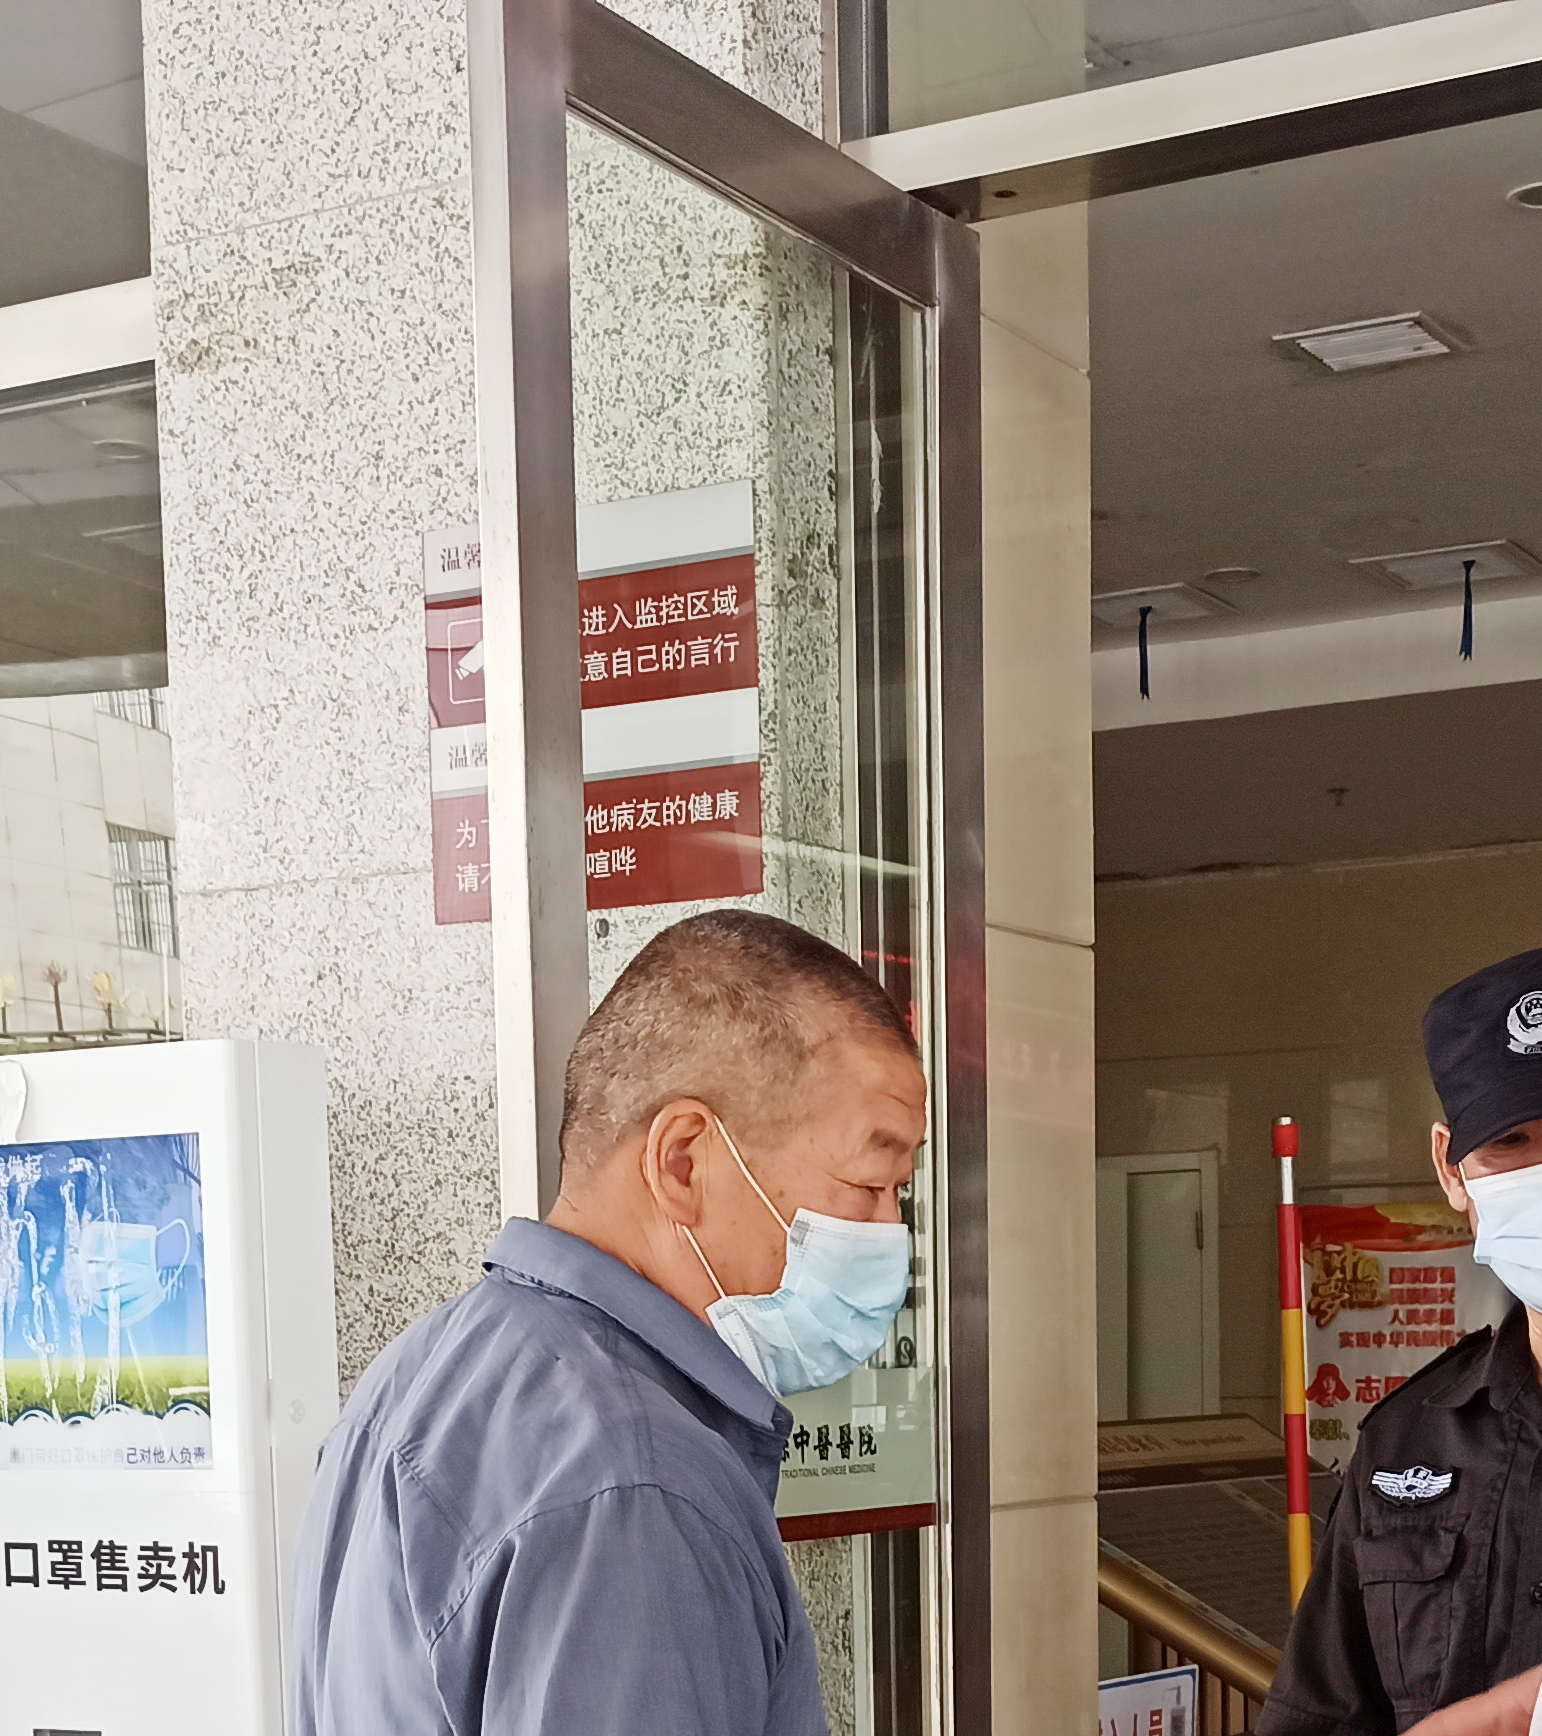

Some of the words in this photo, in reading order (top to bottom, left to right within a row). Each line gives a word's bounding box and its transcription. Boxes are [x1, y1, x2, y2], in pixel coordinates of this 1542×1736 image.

[579, 585, 739, 636] 进入监控区域
[580, 632, 740, 682] 意自己的言行
